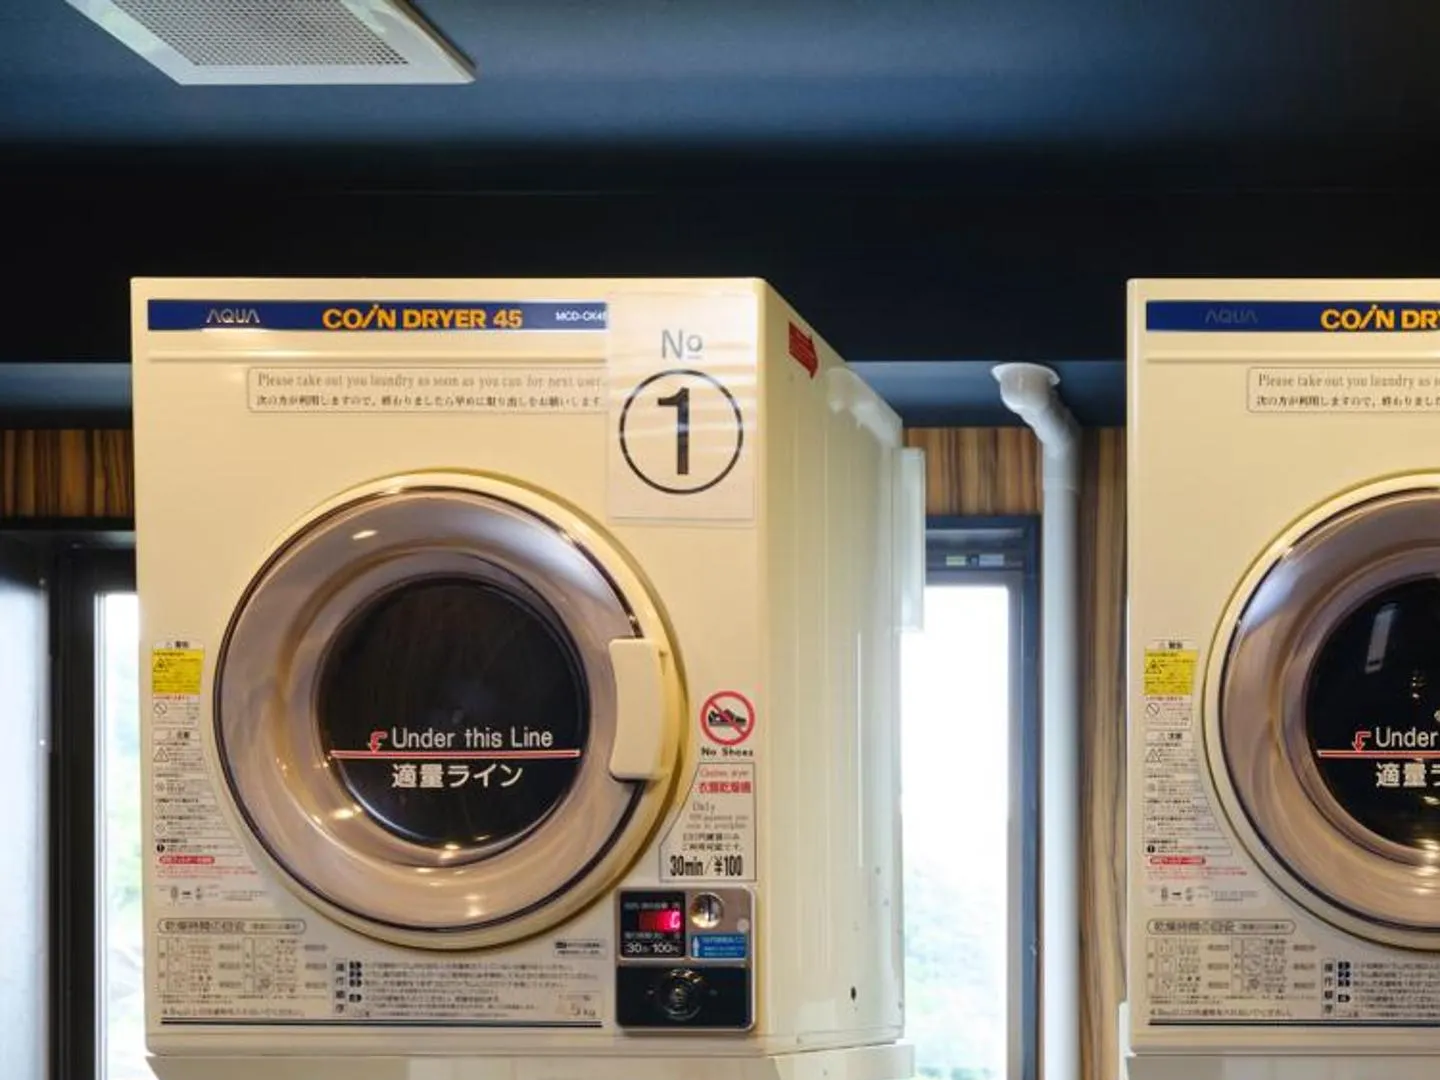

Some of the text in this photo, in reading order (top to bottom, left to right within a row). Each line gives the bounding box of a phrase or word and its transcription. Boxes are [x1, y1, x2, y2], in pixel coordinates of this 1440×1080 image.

[206, 308, 260, 324] AQUA
[402, 308, 487, 329] DRYER
[493, 308, 523, 329] 45
[258, 372, 293, 387] Please
[347, 377, 367, 390] you
[479, 377, 499, 390] you
[1258, 372, 1294, 387] Please
[1325, 374, 1343, 387] out
[1347, 377, 1367, 390] you
[1370, 372, 1414, 390] laundry
[1418, 377, 1431, 387] as
[656, 387, 690, 476] 1
[391, 726, 553, 748] Under this Line
[1375, 726, 1438, 748] Under
[701, 747, 753, 757] No Shoes
[392, 763, 523, 788] 適量ライン
